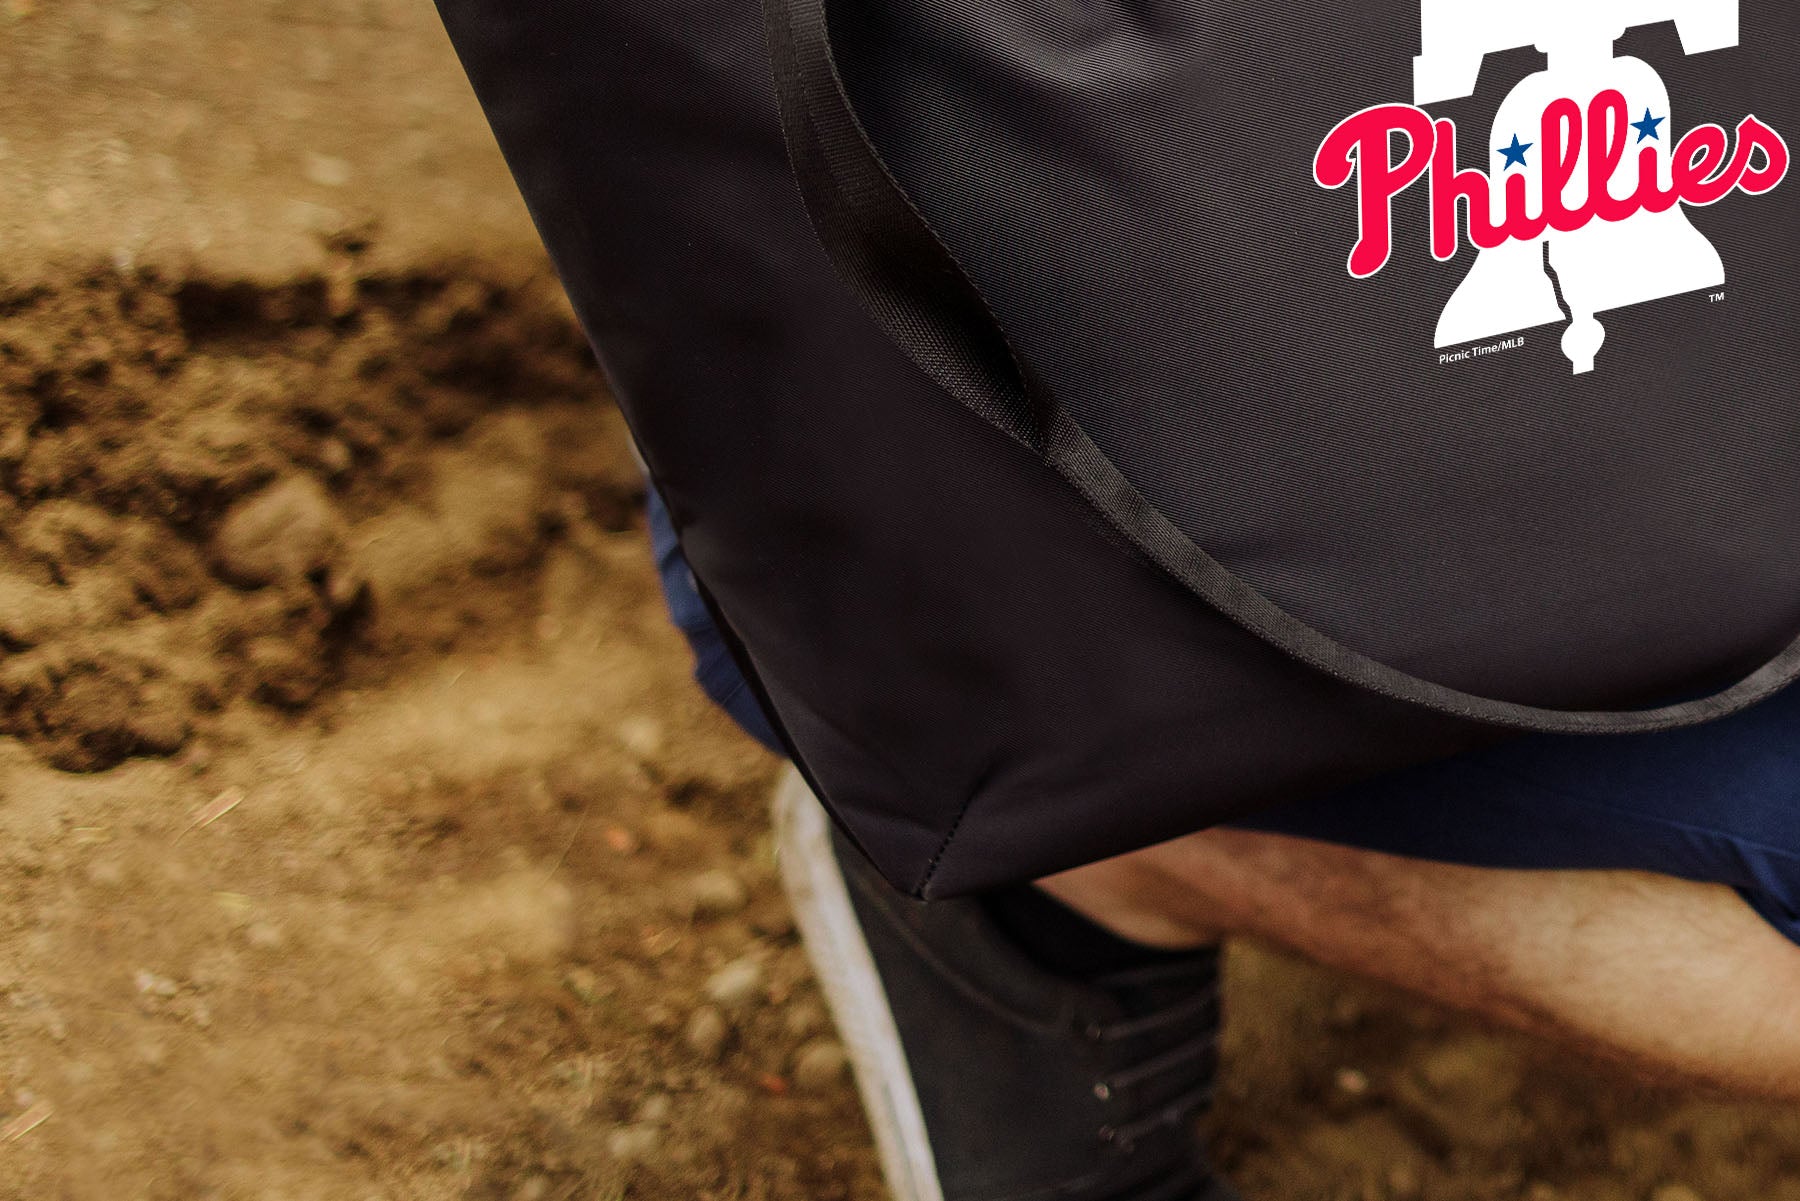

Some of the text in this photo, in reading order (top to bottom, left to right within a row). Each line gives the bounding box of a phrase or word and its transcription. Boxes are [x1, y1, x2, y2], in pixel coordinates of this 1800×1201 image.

[1313, 88, 1789, 279] Phillies
[1439, 336, 1525, 364] Picnic Time/MLB
